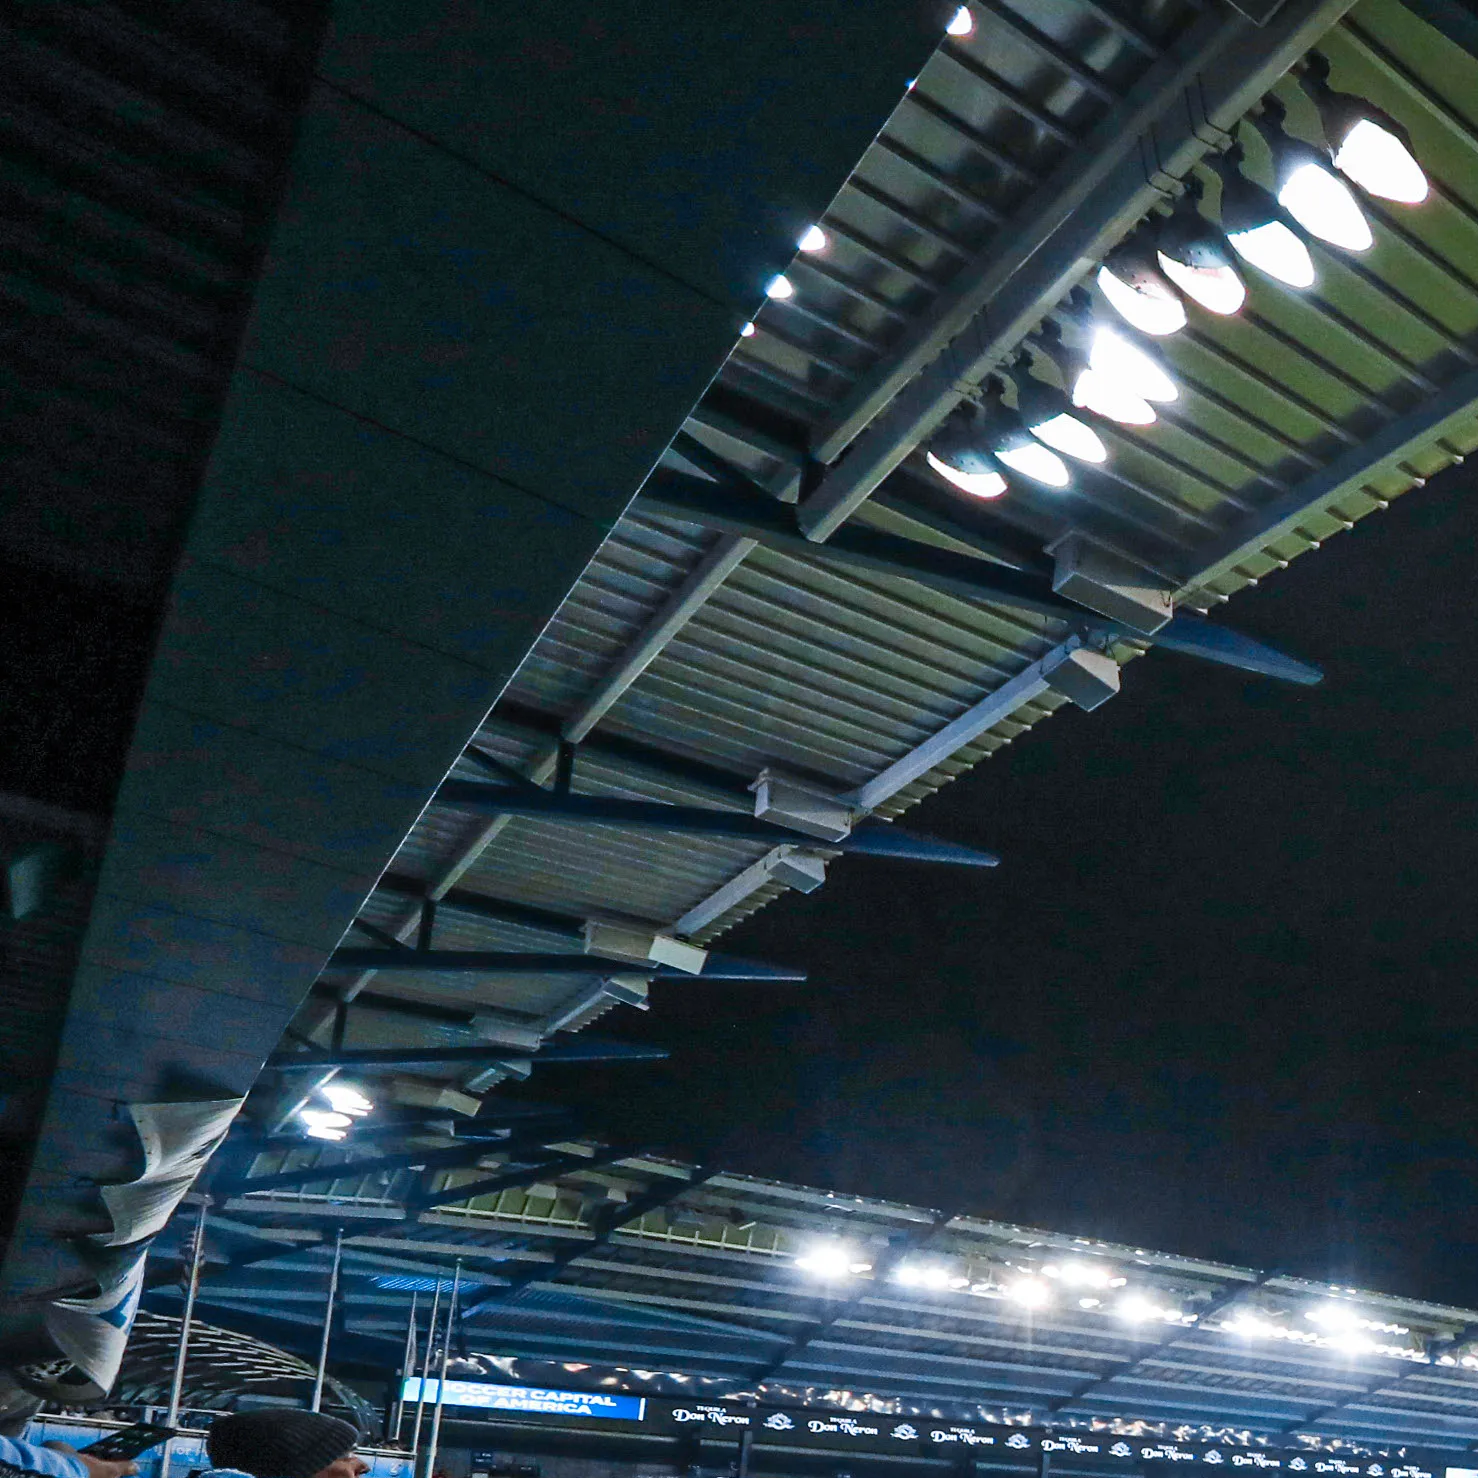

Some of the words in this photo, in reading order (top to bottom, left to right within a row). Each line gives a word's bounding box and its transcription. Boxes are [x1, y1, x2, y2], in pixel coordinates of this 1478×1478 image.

[460, 1394, 496, 1407] OF
[499, 1397, 592, 1415] AMERICA
[530, 1391, 617, 1407] CAPITAL
[696, 1405, 726, 1413] TEQUILA
[672, 1408, 704, 1422] Don
[708, 1412, 750, 1426] Neron
[807, 1420, 839, 1433] Don
[930, 1430, 957, 1443] Don
[1041, 1439, 1065, 1452] Don
[1140, 1447, 1164, 1460] Don
